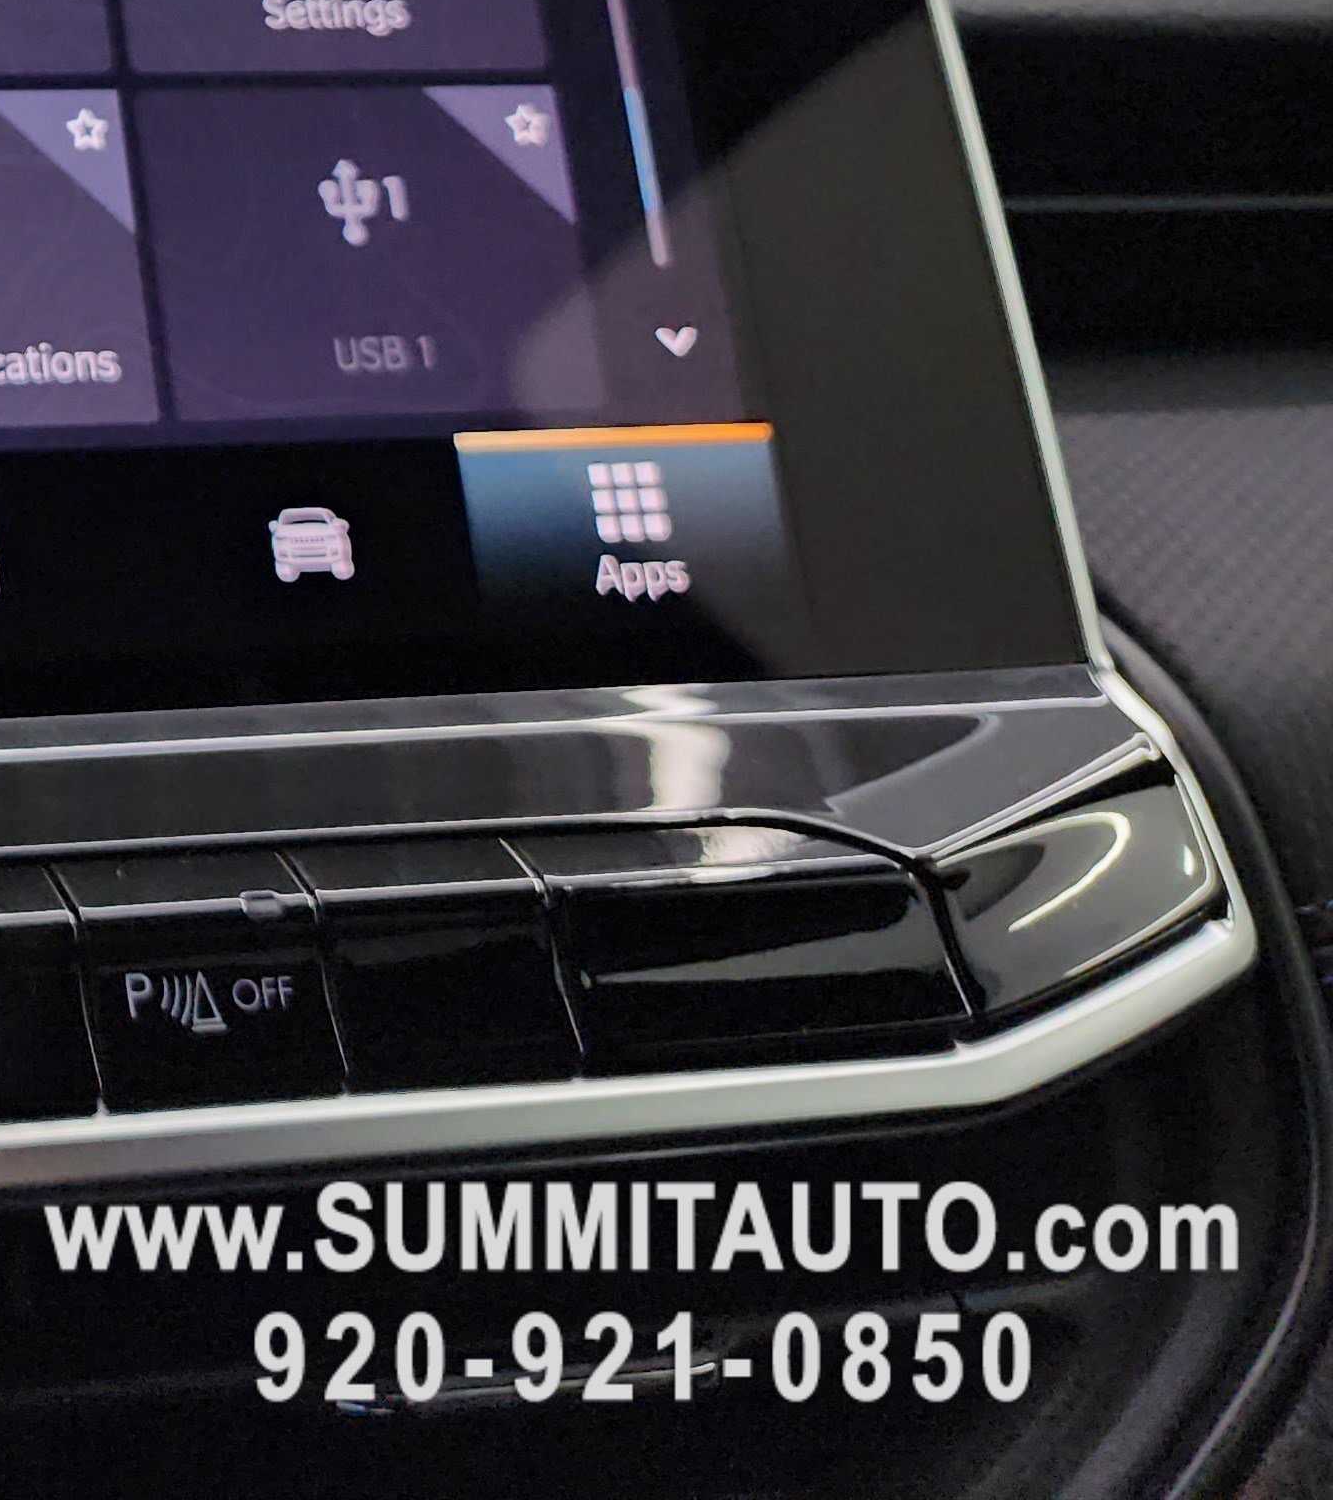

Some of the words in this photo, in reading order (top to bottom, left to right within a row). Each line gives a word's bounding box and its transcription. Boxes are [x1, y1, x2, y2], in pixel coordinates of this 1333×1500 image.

[334, 336, 411, 373] USB
[416, 334, 437, 371] 1
[596, 555, 691, 603] Apps
[232, 976, 294, 1012] OFF
